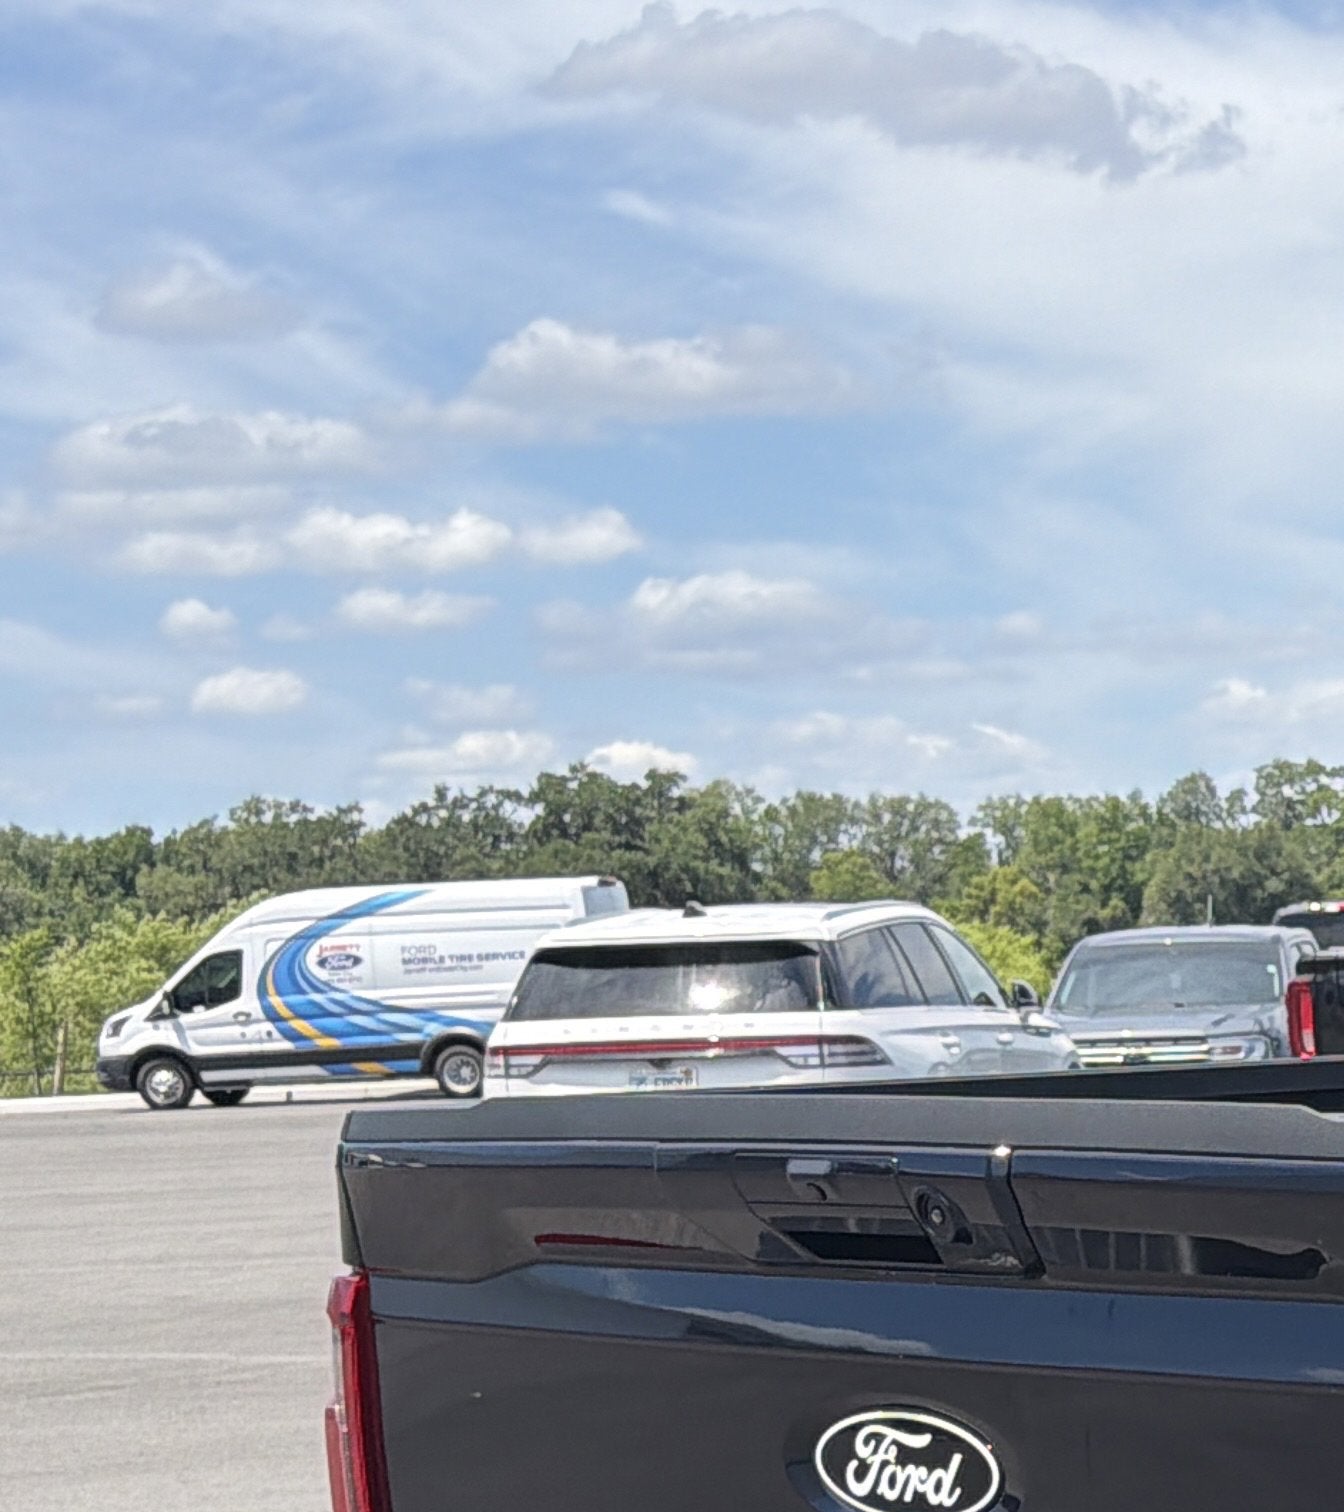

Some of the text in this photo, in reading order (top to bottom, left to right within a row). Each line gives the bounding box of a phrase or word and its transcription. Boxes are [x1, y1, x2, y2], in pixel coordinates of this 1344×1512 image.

[400, 945, 437, 956] FORD
[402, 950, 526, 966] MOBILE TIRE SERVICE
[845, 1423, 964, 1508] Ford
